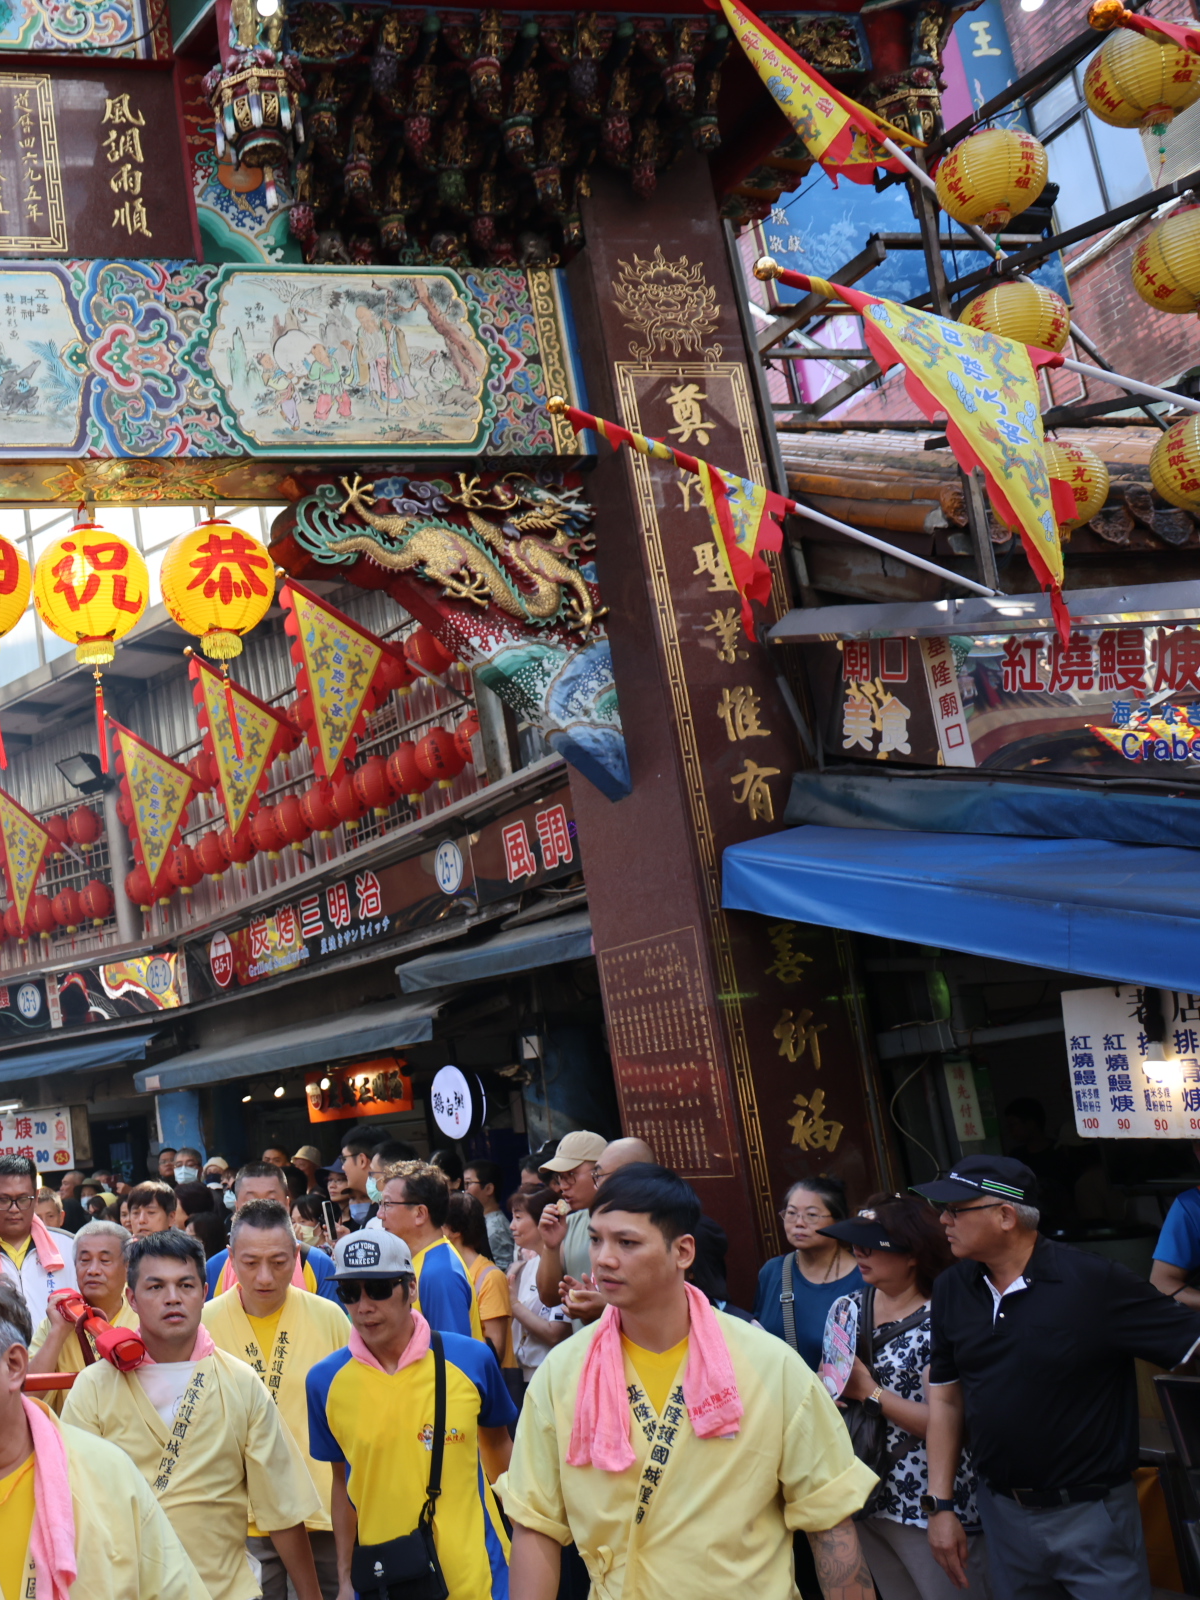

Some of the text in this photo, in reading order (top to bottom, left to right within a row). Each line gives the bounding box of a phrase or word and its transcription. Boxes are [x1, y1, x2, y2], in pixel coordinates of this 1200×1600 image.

[101, 93, 153, 238] 風調雨順
[940, 325, 1029, 447] 田都元帥
[51, 541, 143, 614] 祝
[186, 531, 269, 605] 恭
[926, 637, 965, 749] 基隆廟口
[843, 697, 911, 754] 美食
[439, 849, 459, 885] 25-1
[502, 804, 573, 883] 風調
[251, 870, 382, 958] 炭烤三明治
[150, 966, 168, 989] 25-2
[214, 956, 231, 974] 25-1
[21, 991, 37, 1012] 25-3
[1070, 1036, 1097, 1086] 紅燒鰻
[1103, 1034, 1136, 1113] 紅燒鰻焿
[951, 1066, 978, 1136] 請先付款
[1082, 1118, 1099, 1129] 100
[1117, 1118, 1131, 1130] 90
[1154, 1119, 1169, 1131] 90
[35, 1122, 47, 1134] 70
[36, 1150, 49, 1163] 90
[348, 1242, 375, 1252] NEW YORK
[348, 1257, 375, 1266] YANKEES
[153, 1372, 204, 1493] 基隆護國城隍廟
